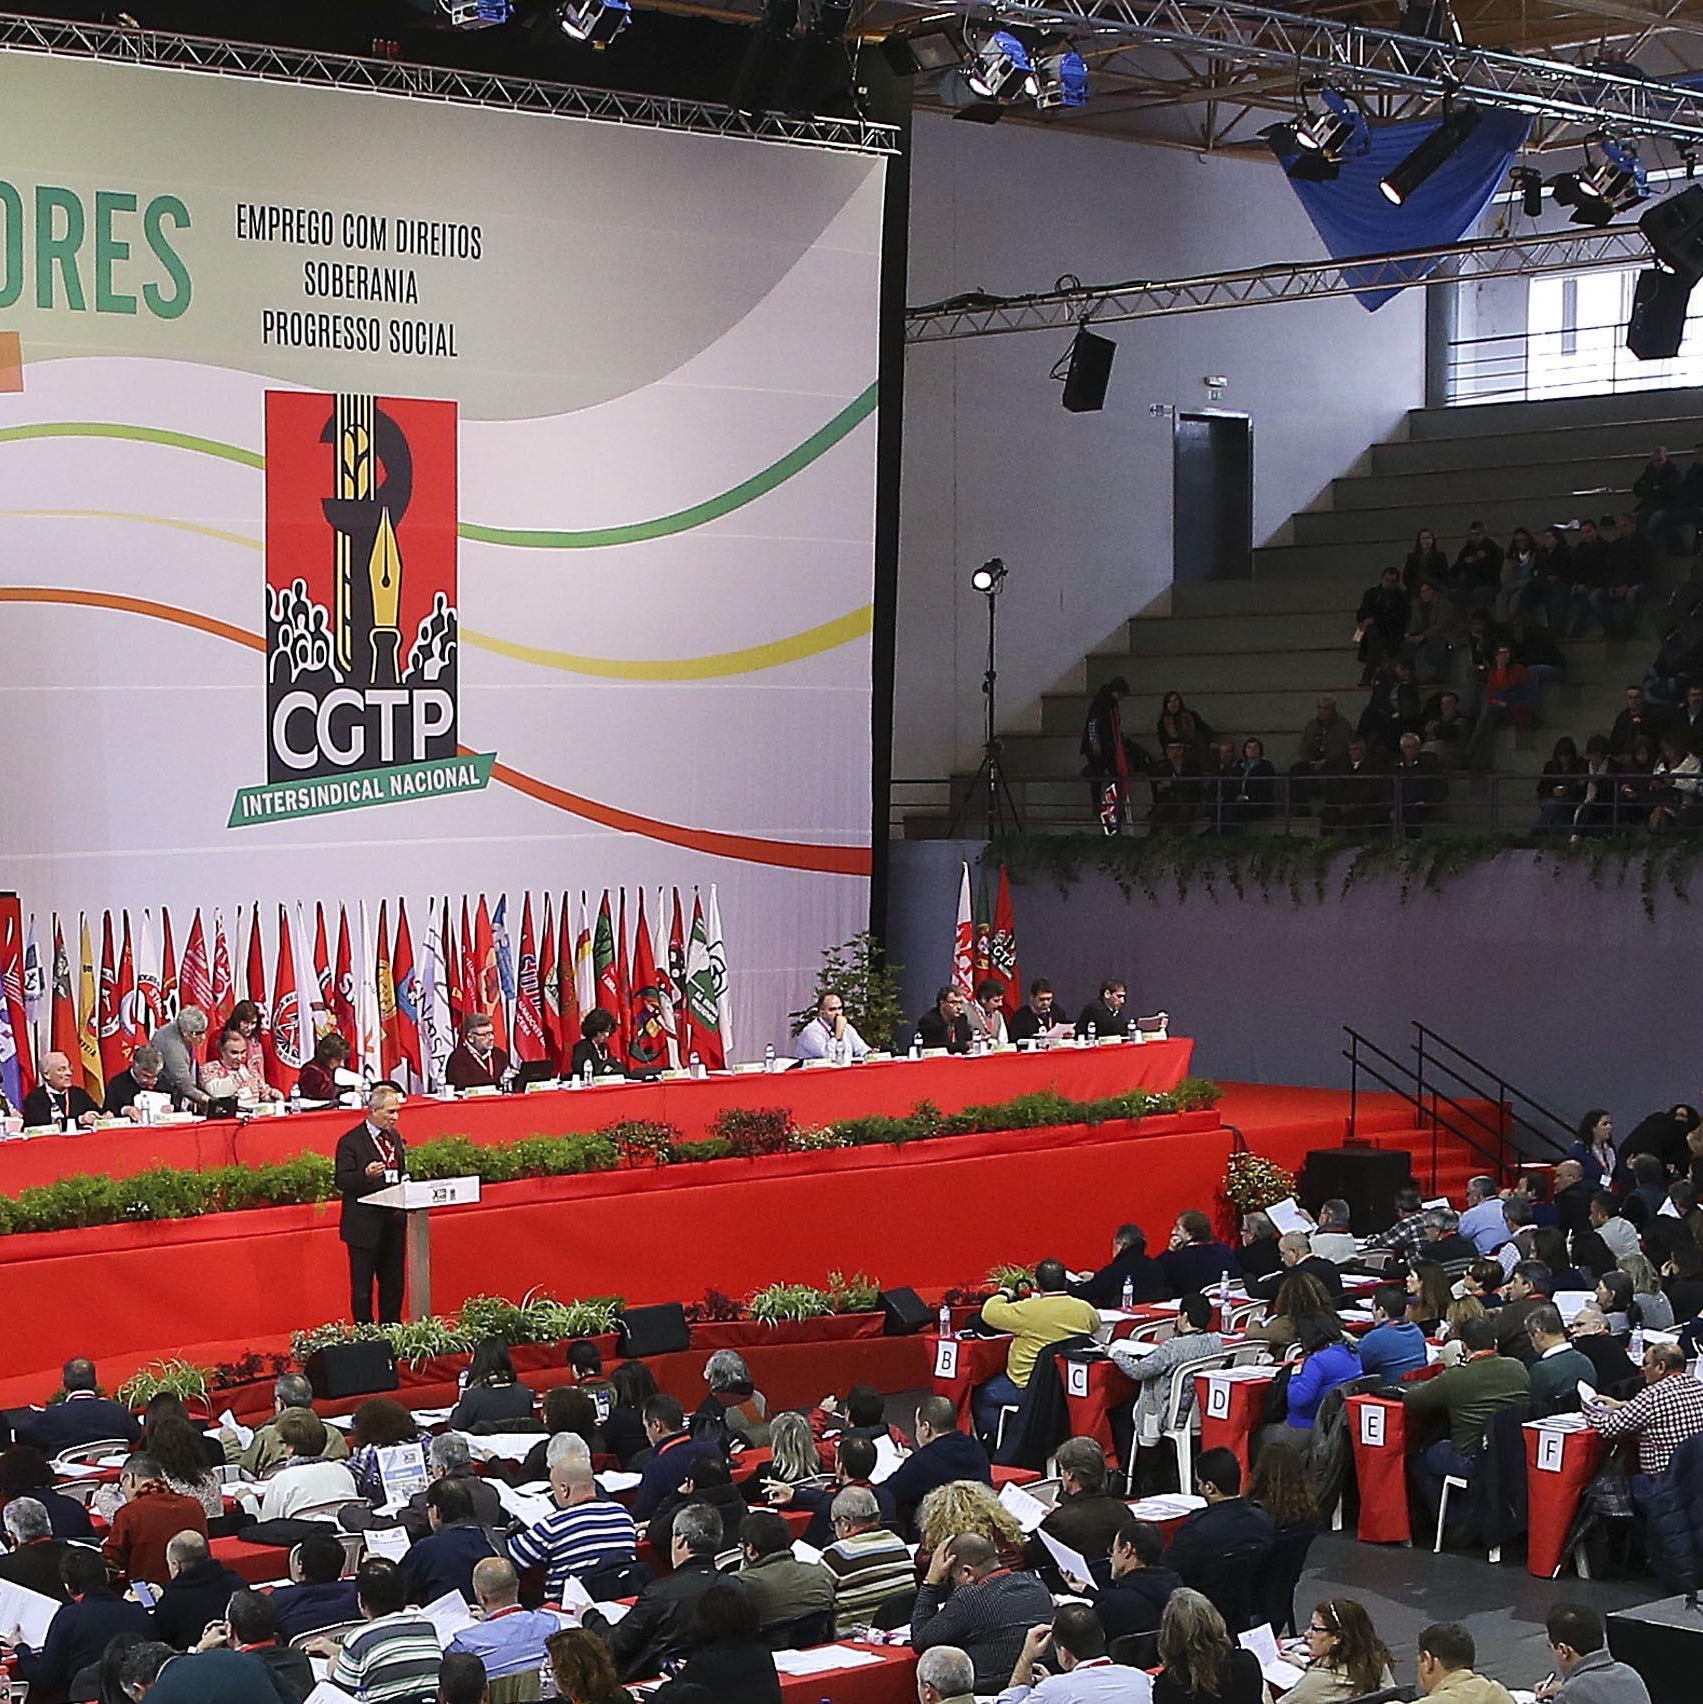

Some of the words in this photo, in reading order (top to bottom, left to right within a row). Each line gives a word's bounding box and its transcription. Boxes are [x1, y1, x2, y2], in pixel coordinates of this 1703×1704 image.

[237, 203, 334, 247] EMPREGO
[342, 213, 387, 251] COM
[396, 219, 482, 260] DIREITOS
[304, 261, 419, 304] SOBERANIA
[262, 310, 381, 352] PROGRESSO
[389, 320, 458, 357] SOCIAL
[272, 688, 455, 770] CGTP
[242, 779, 385, 818] INTERSINDICAL
[390, 764, 481, 794] NACIONAL
[941, 1350, 952, 1370] B
[1072, 1368, 1083, 1389] C
[1213, 1389, 1225, 1410] D
[1368, 1416, 1378, 1437] E
[1546, 1440, 1557, 1461] F
